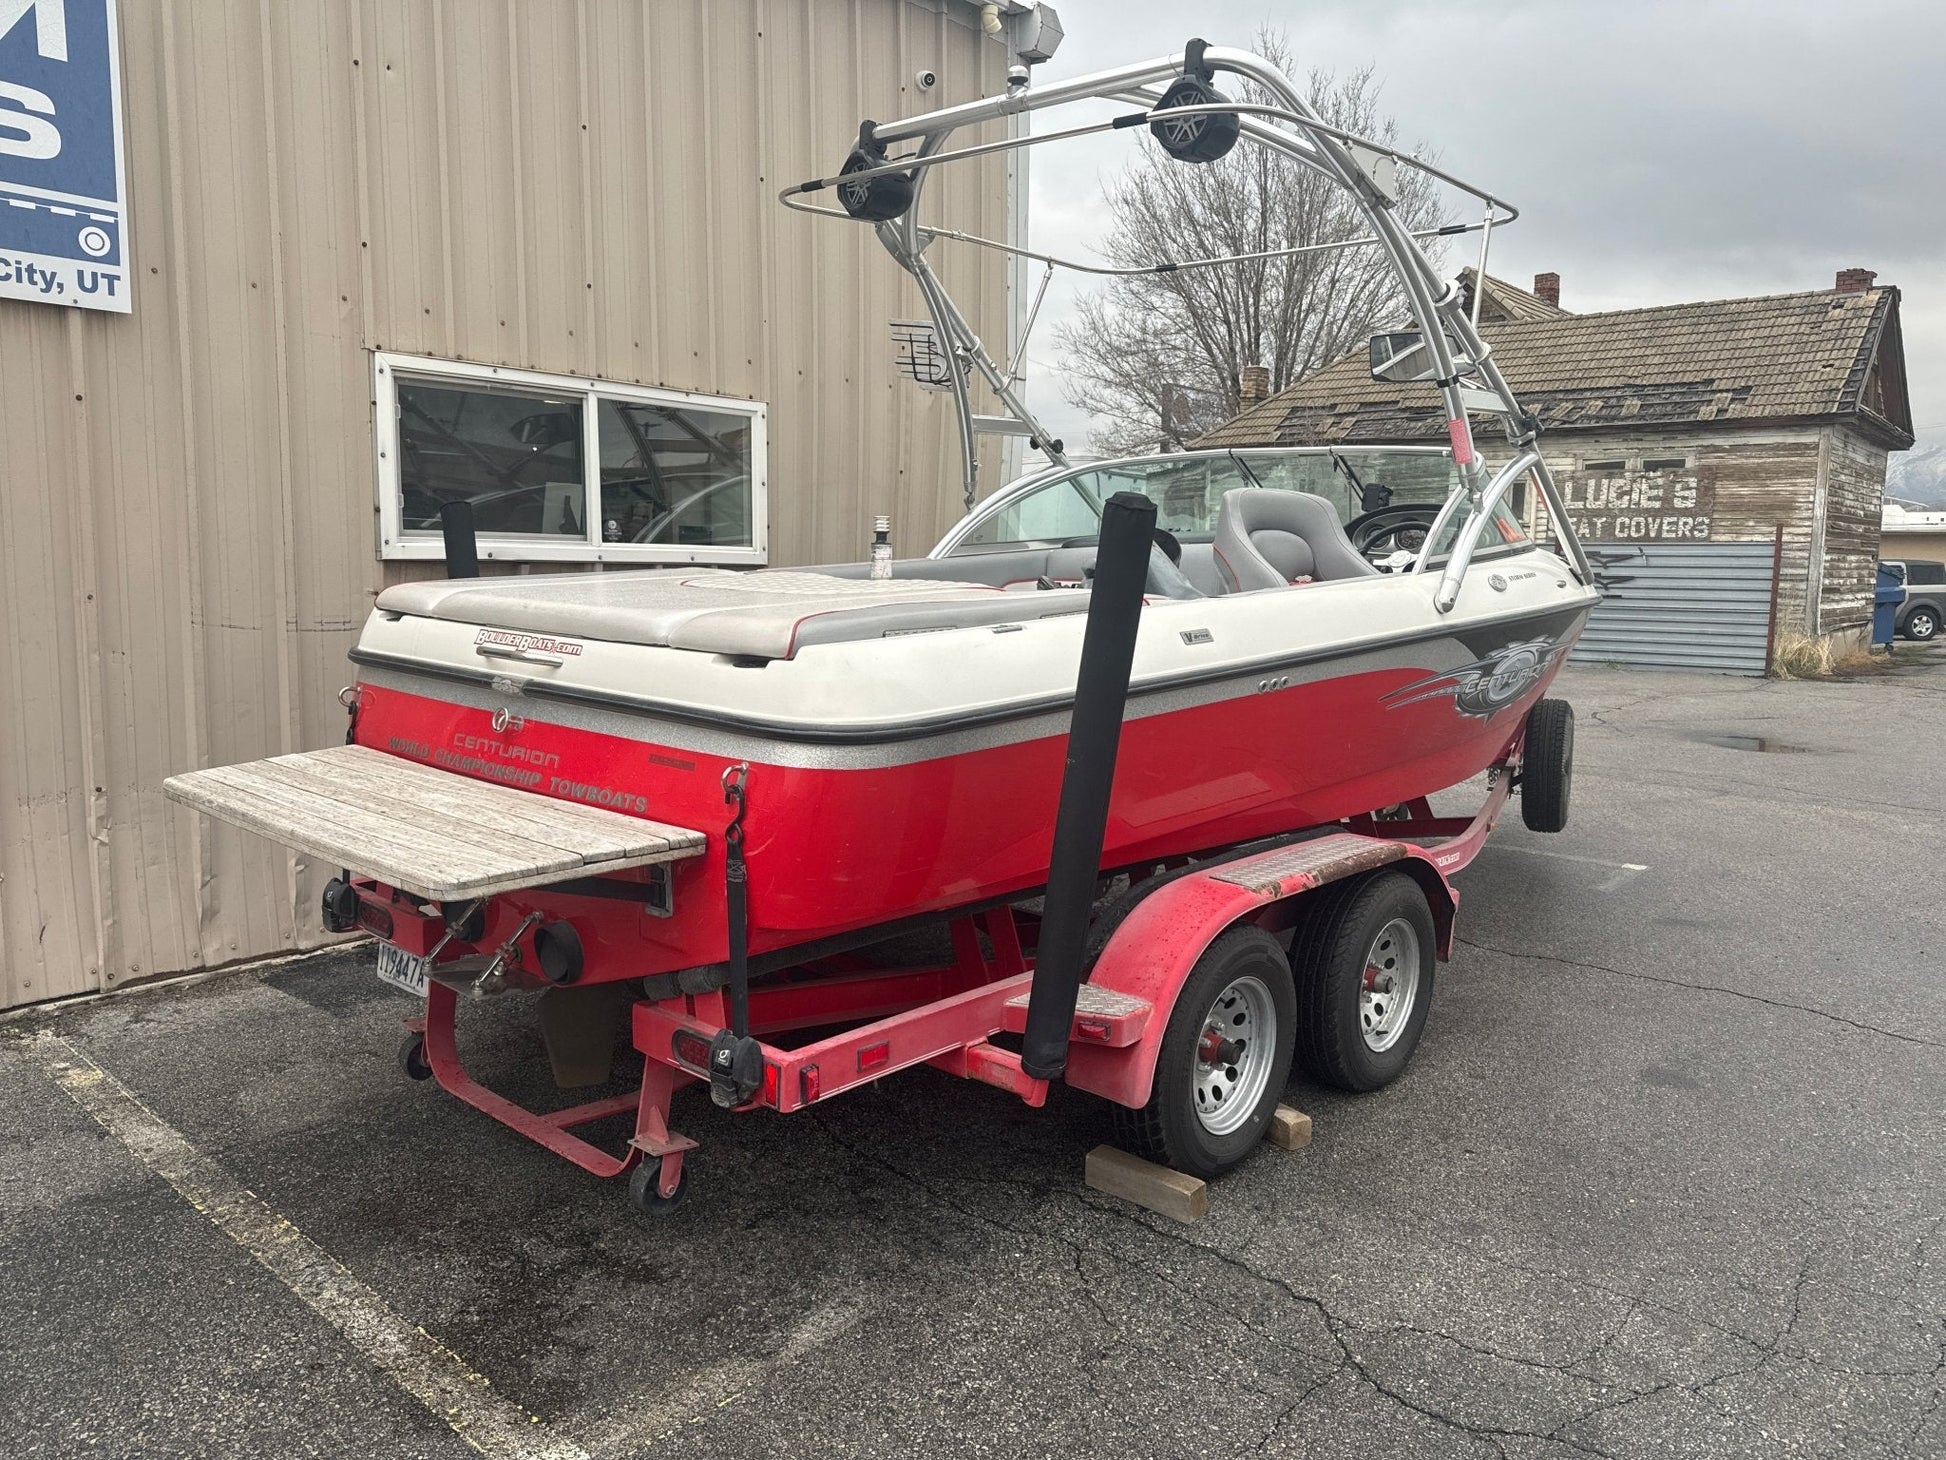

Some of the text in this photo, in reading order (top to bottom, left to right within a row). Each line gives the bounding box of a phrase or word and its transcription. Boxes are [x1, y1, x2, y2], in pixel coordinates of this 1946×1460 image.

[0, 257, 121, 297] City, UT
[1614, 516, 1711, 538] COVERS
[453, 733, 560, 768] CENTURION
[389, 736, 649, 814] WORLD CHAMPIONSHIP TOWBOATS
